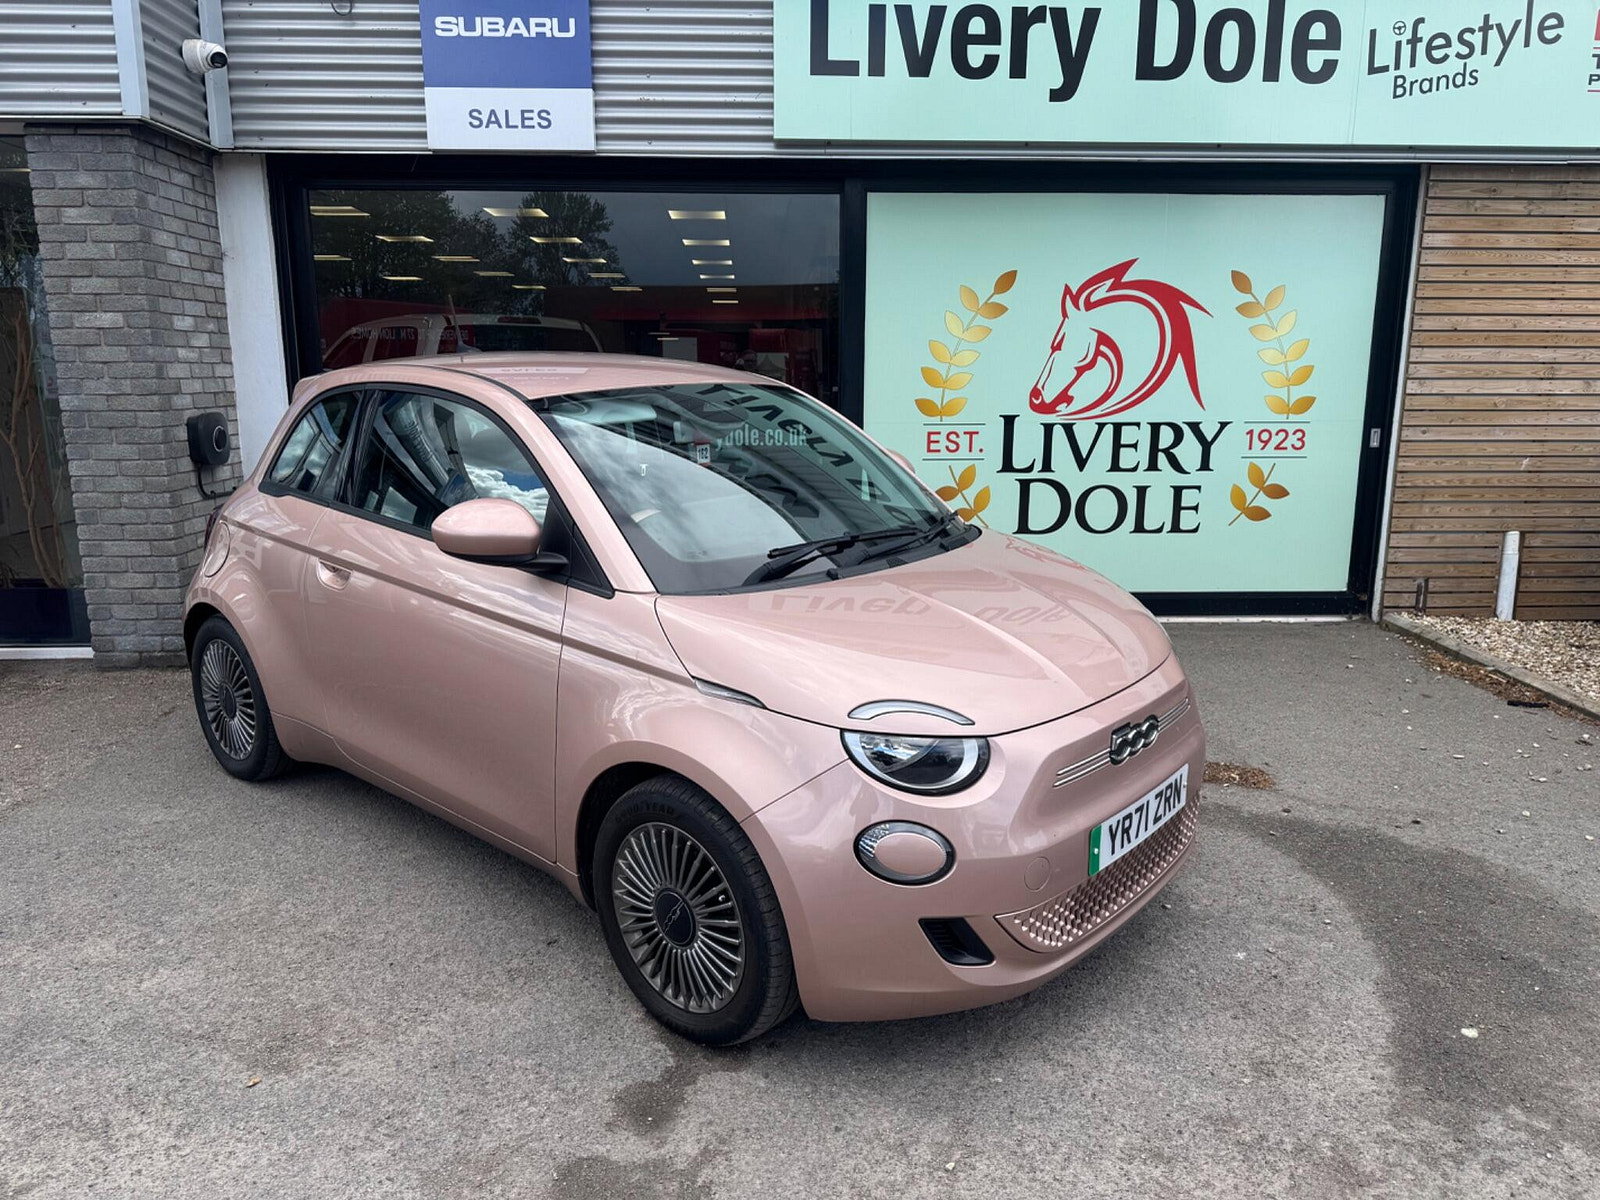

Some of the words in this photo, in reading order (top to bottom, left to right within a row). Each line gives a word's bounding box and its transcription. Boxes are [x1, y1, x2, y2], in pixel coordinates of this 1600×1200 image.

[434, 16, 576, 38] SUBARU
[809, 0, 1102, 103] Livery
[1135, 0, 1342, 85] Dole
[1367, 0, 1565, 76] Lifestyle
[1392, 62, 1479, 100] Brands
[468, 108, 553, 129] SALES
[926, 430, 984, 453] EST.
[996, 414, 1234, 475] LIVERY
[1245, 428, 1306, 451] 1923
[1012, 478, 1202, 535] DOLE
[1110, 714, 1160, 765] 500
[1108, 801, 1150, 855] YR71
[1153, 774, 1182, 826] ZRN
